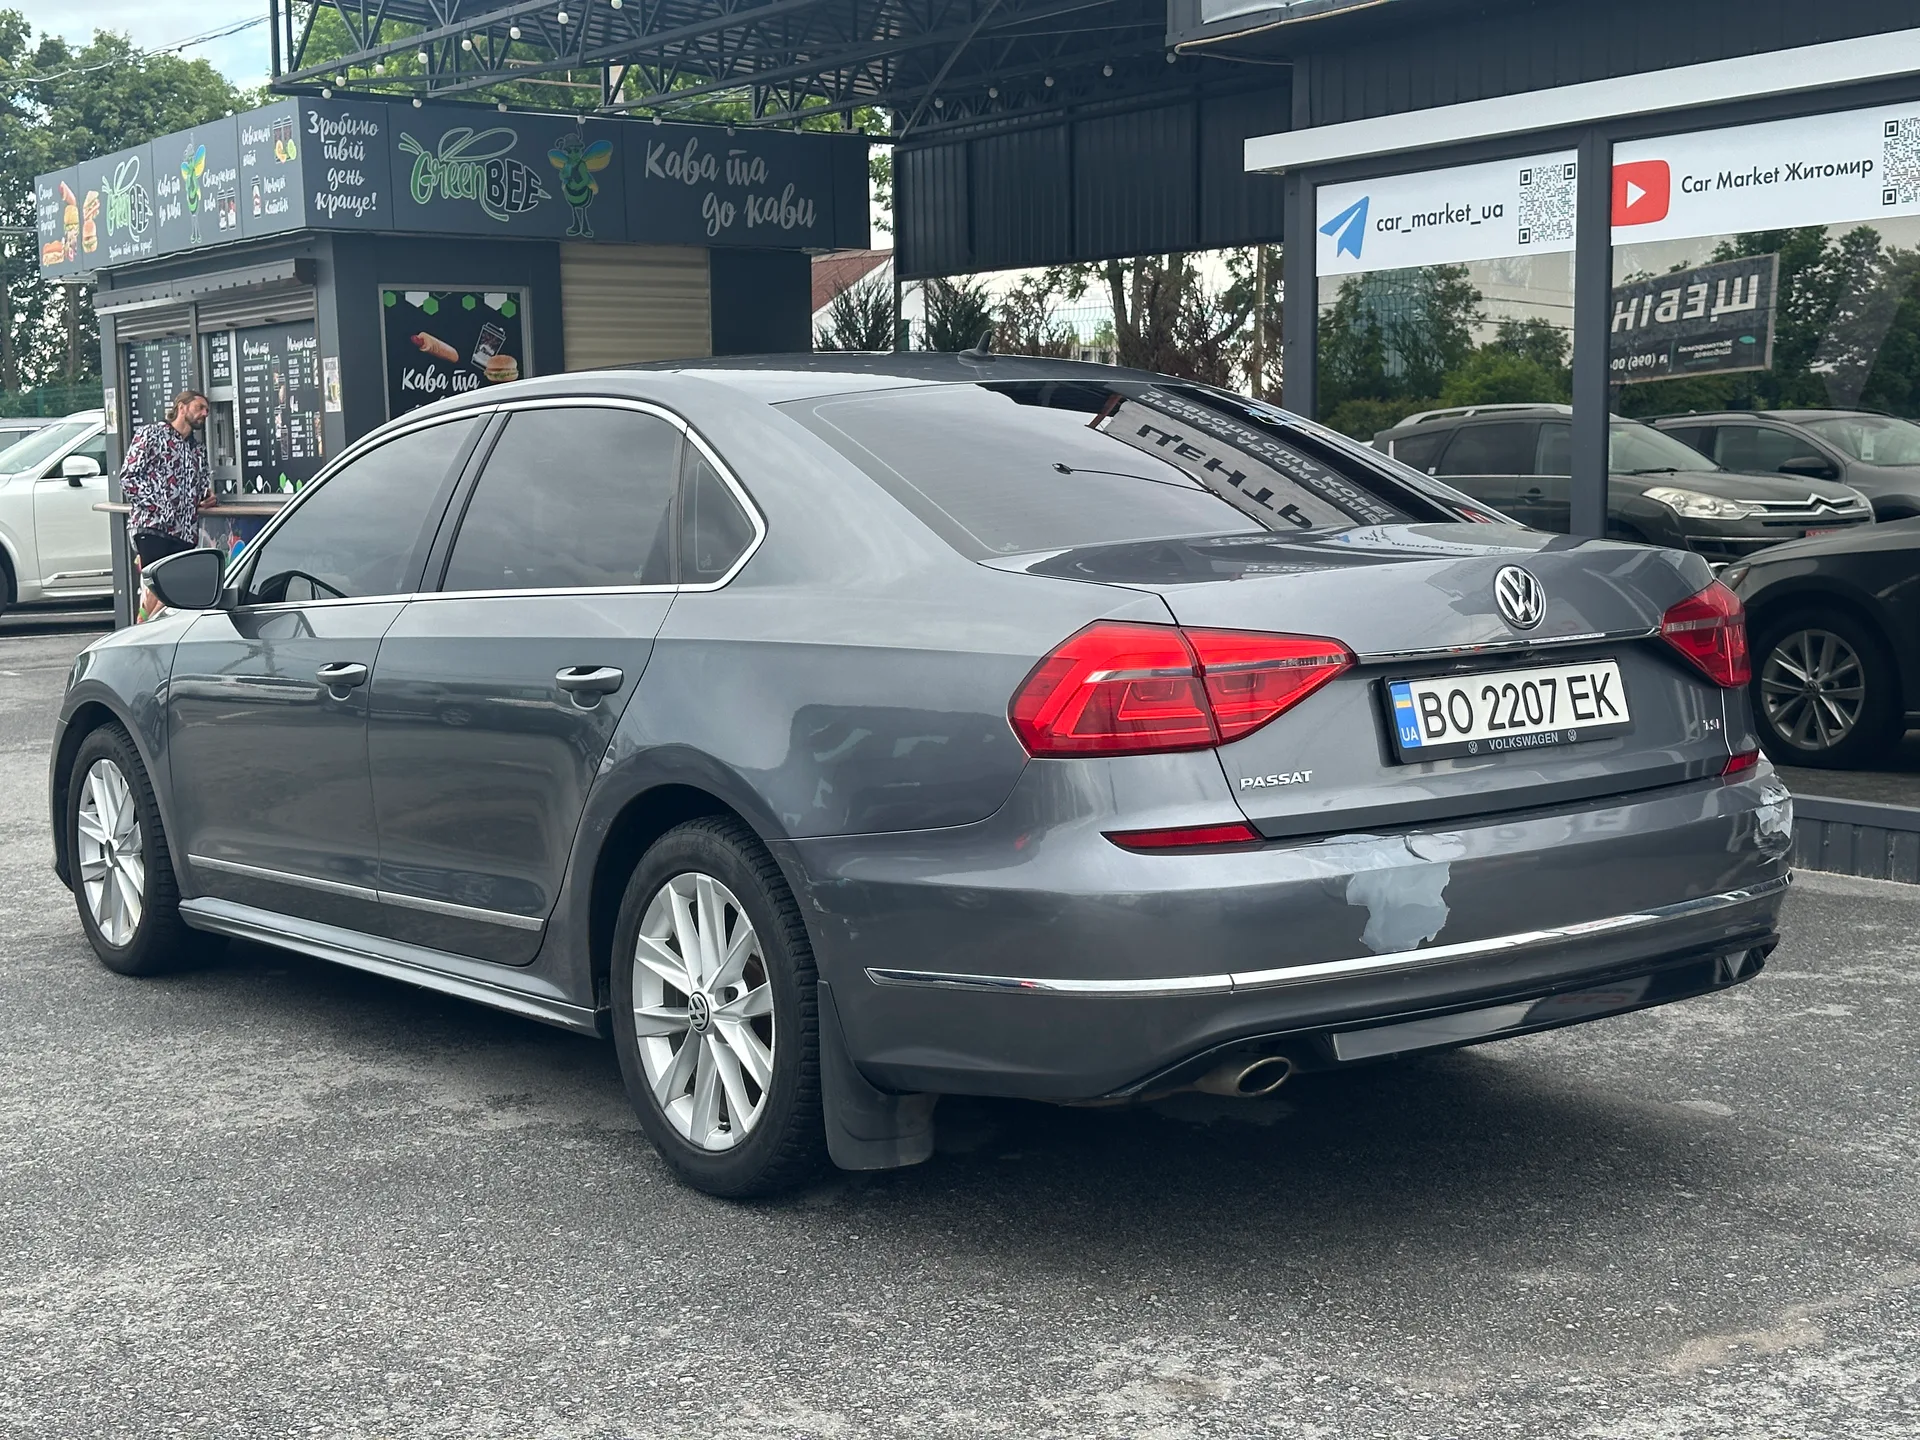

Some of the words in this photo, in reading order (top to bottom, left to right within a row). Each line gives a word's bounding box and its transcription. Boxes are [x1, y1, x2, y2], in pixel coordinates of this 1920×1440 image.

[307, 110, 379, 142] Зробимо
[324, 137, 366, 162] твій
[645, 137, 719, 185] Кава
[726, 149, 769, 185] та
[327, 167, 365, 191] день
[1681, 176, 1711, 193] Car
[1716, 166, 1780, 190] Market
[1784, 159, 1874, 185] Житомир
[315, 192, 377, 219] краще!
[702, 192, 736, 237] до
[744, 183, 816, 230] кави
[1376, 203, 1504, 233] car_market_ua
[402, 364, 449, 393] Кава
[452, 369, 480, 391] та
[1418, 689, 1474, 739] BO
[1481, 678, 1557, 731] 2207
[1566, 672, 1619, 721] EK
[1401, 727, 1419, 742] UA
[1488, 732, 1559, 751] VOLKSWAGEN
[1240, 770, 1313, 791] PASSAT
